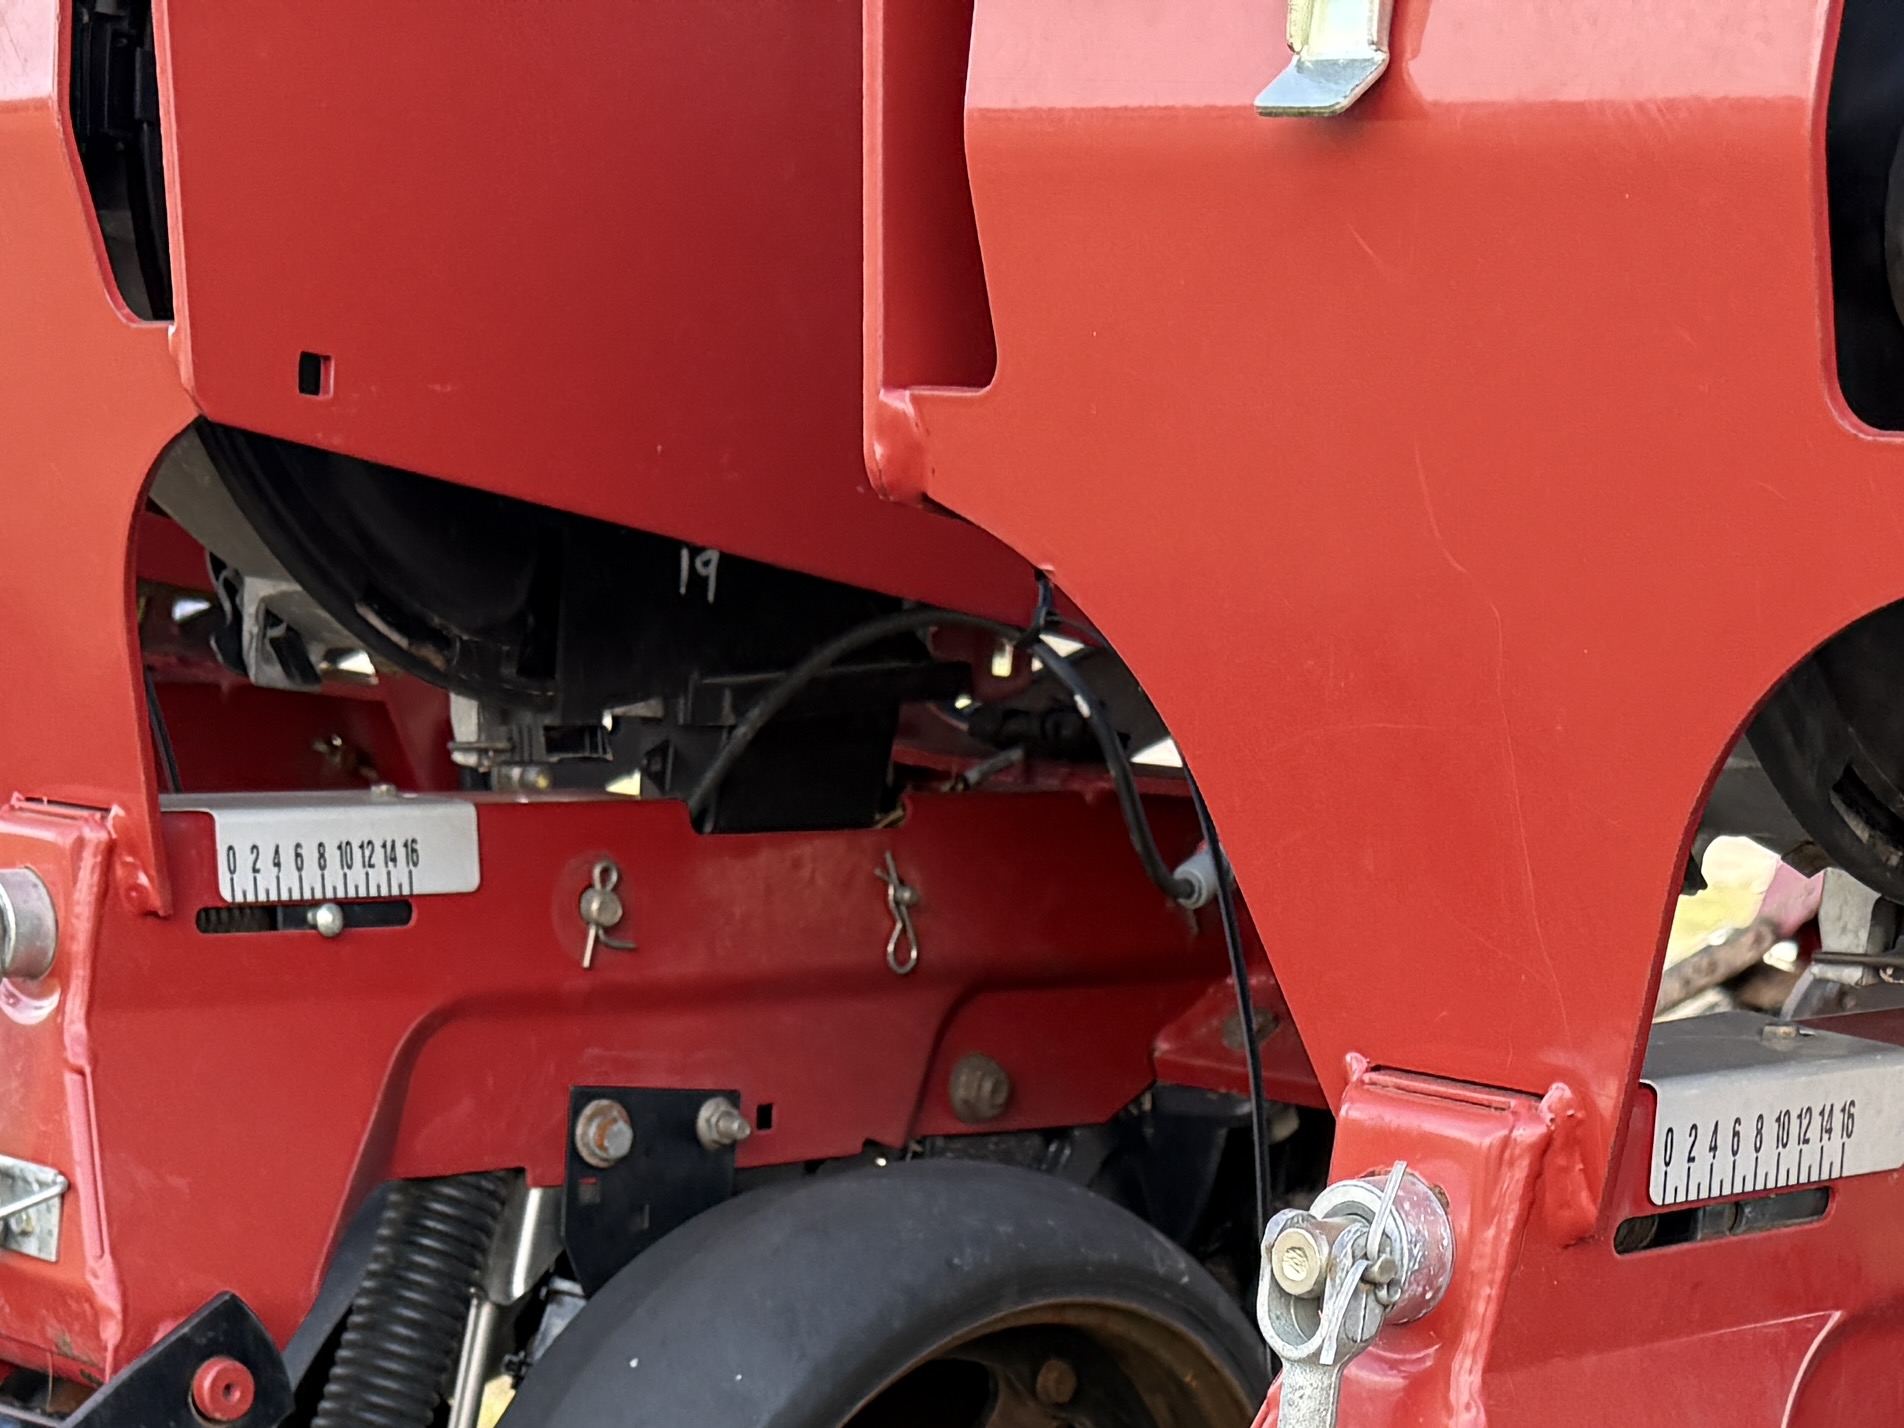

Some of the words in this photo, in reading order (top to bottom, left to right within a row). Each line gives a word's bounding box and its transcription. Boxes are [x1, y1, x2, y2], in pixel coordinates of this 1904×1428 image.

[679, 547, 720, 604] 19
[226, 845, 237, 875] 0
[250, 844, 261, 874] 2
[272, 844, 281, 873] 4
[294, 842, 304, 872] 6
[317, 842, 327, 871] 8
[337, 841, 353, 870] 10
[359, 840, 376, 869] 12
[381, 839, 397, 868] 14
[403, 838, 420, 868] 16
[1664, 1127, 1673, 1168] 0
[1687, 1123, 1698, 1164] 2
[1708, 1120, 1719, 1160] 4
[1732, 1117, 1741, 1158] 6
[1754, 1113, 1764, 1154] 8
[1775, 1109, 1791, 1150] 10
[1797, 1106, 1812, 1146] 12
[1819, 1103, 1834, 1142] 14
[1840, 1099, 1856, 1139] 16
